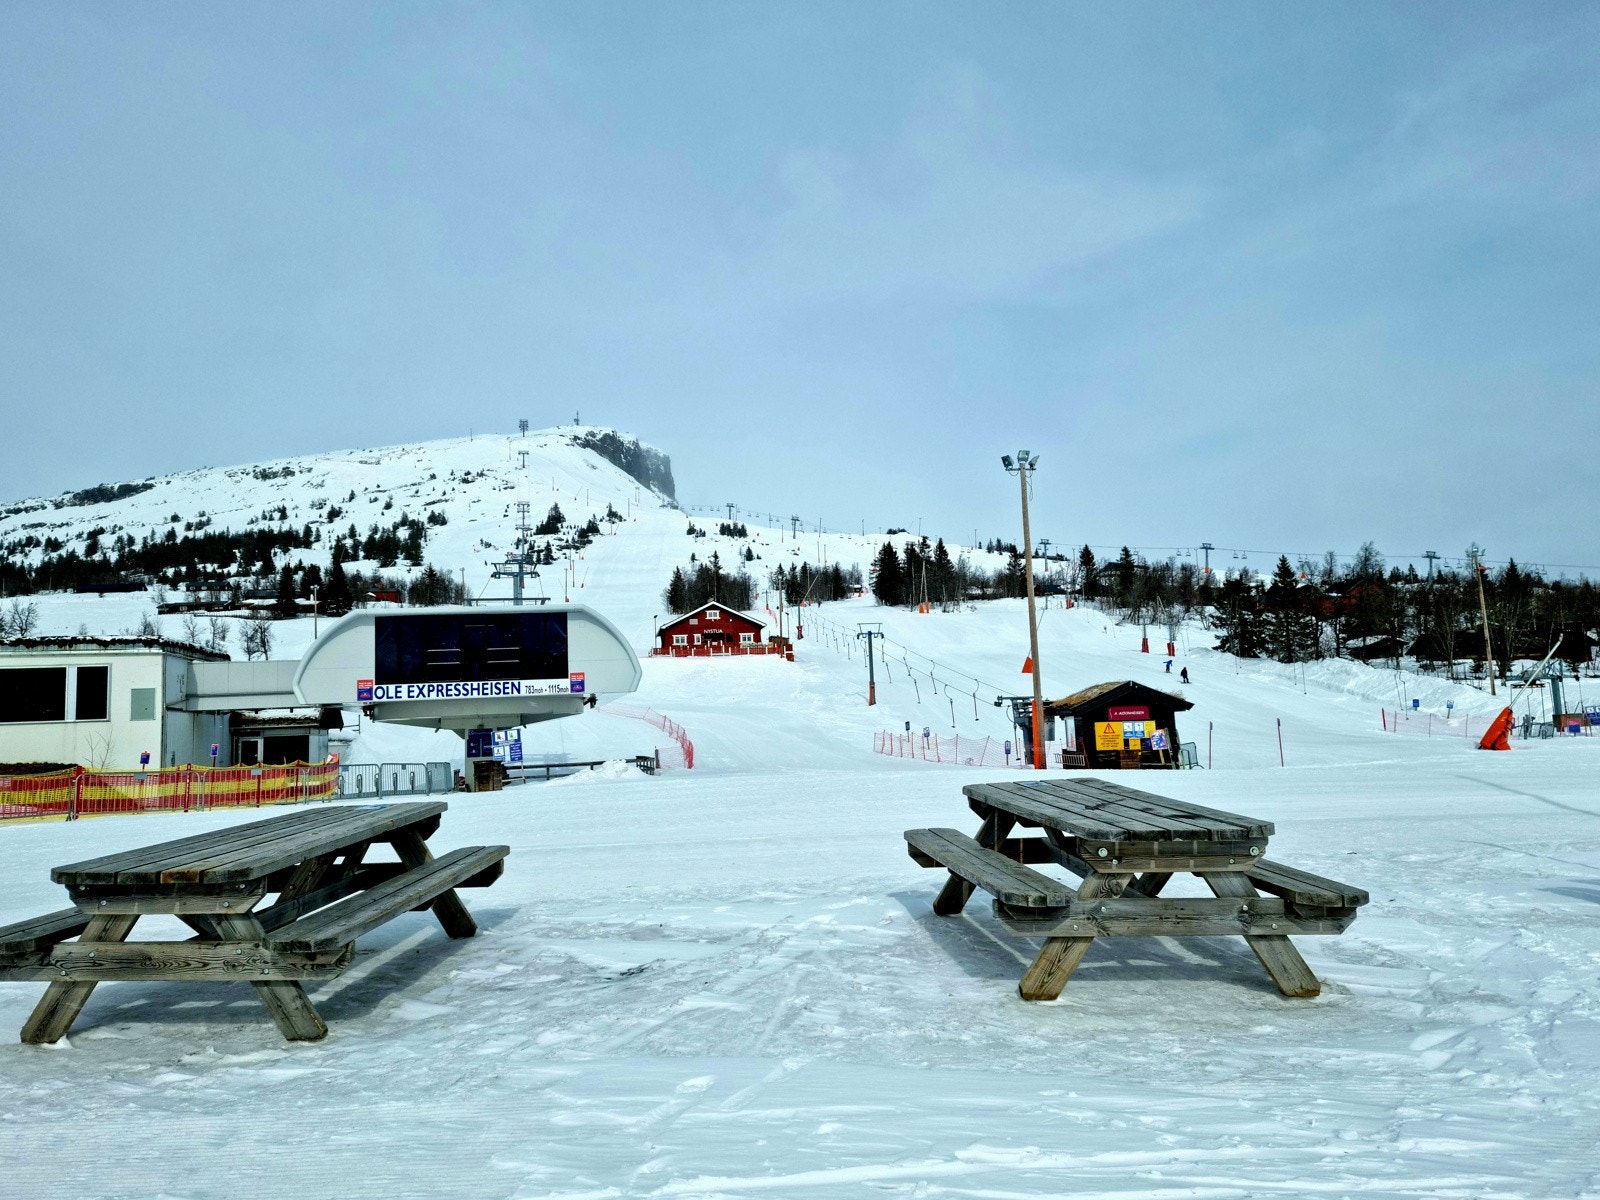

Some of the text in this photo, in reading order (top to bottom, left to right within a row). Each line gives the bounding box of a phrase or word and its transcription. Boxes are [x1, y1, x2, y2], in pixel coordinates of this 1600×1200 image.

[374, 685, 402, 700] OLE
[407, 681, 521, 699] EXPRESSHEISEN
[525, 685, 543, 694] 783moh
[548, 684, 569, 693] 1115moh
